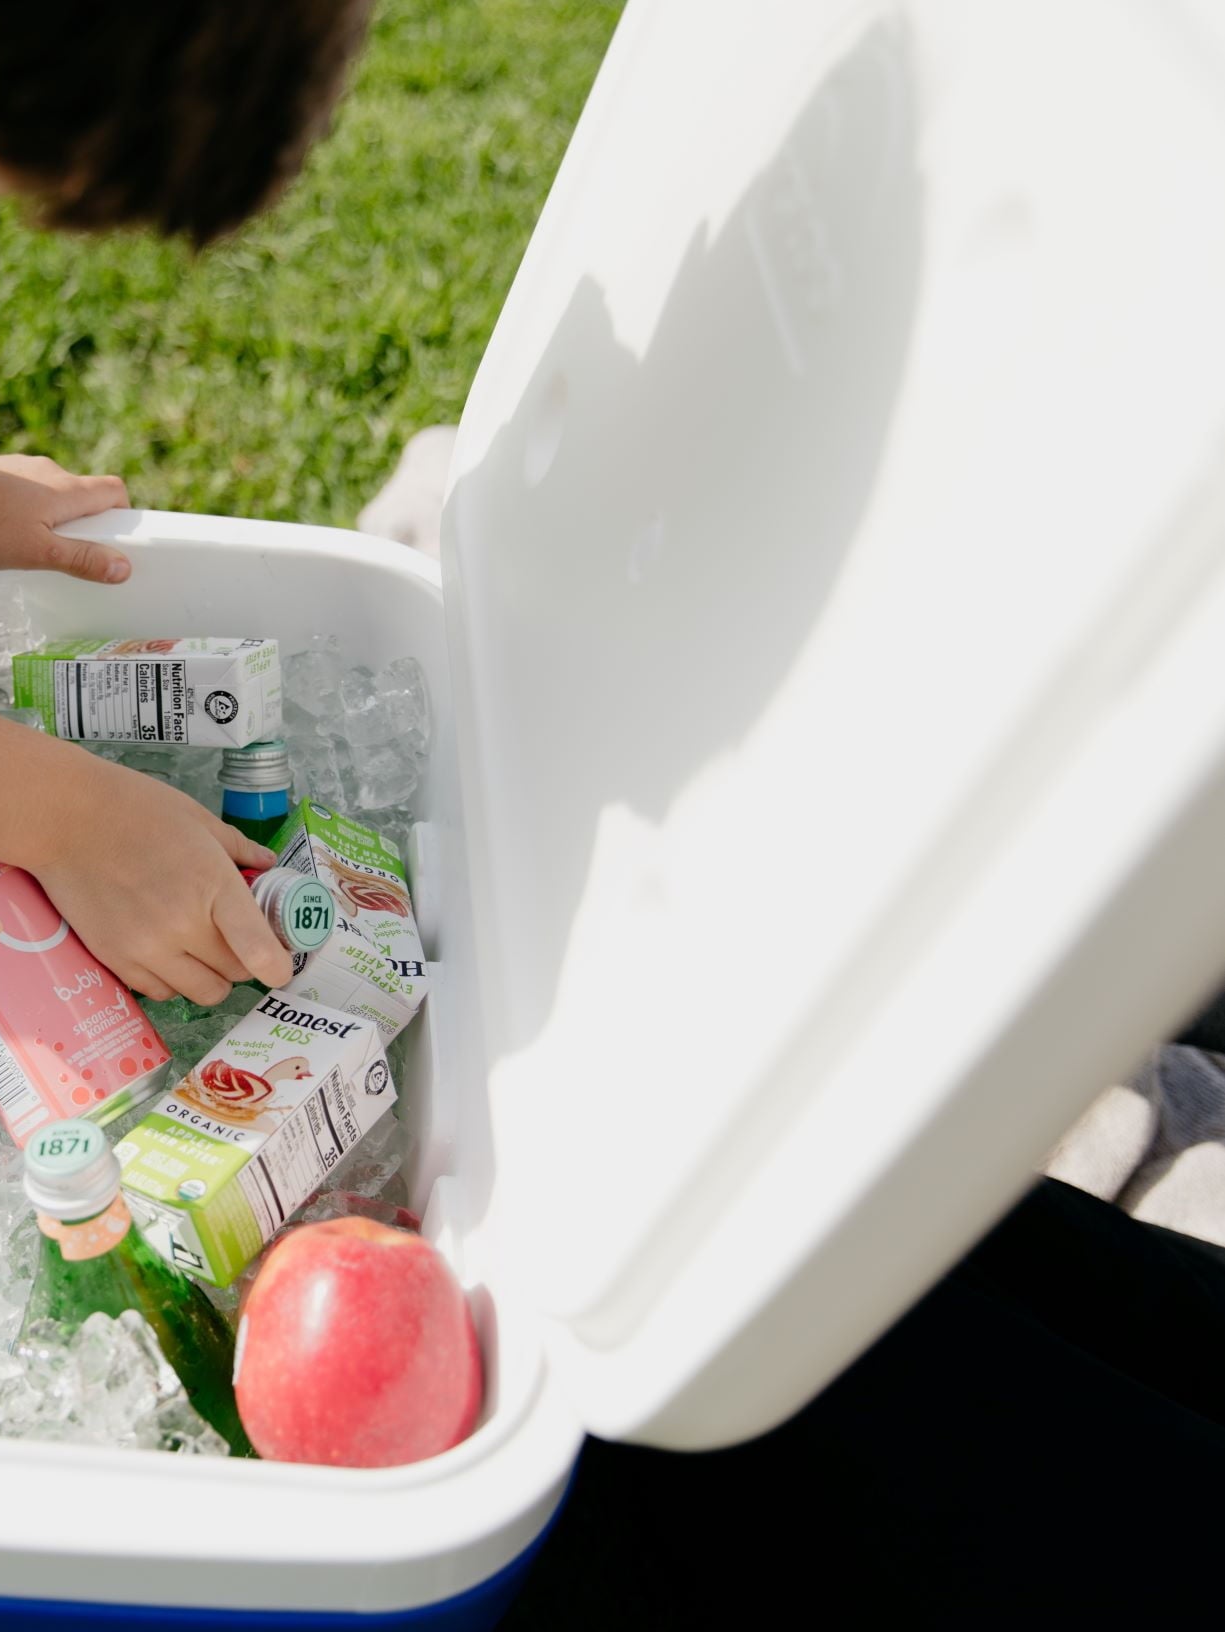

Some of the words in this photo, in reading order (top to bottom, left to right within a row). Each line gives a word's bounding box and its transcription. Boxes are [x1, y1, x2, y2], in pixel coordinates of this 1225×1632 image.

[139, 663, 150, 703] Calories
[171, 663, 184, 710] Nutrition
[187, 700, 195, 716] JUICE
[142, 725, 156, 741] 35
[173, 712, 185, 742] Facts
[324, 844, 400, 883] ORGANIC
[302, 895, 322, 904] SINCE
[294, 906, 329, 931] 1871
[375, 928, 403, 939] added
[53, 968, 103, 1002] bubly
[350, 965, 398, 994] APPLEY
[256, 996, 356, 1039] Honest
[226, 1039, 240, 1047] No
[243, 1040, 274, 1050] added
[329, 1070, 347, 1116] Nutrition
[341, 1113, 357, 1143] Facts
[144, 1127, 177, 1148] EVER
[165, 1104, 245, 1142] ORGANIC
[306, 1097, 322, 1136] Calories
[323, 1147, 339, 1168] 35
[38, 1137, 90, 1157] 1871
[165, 1125, 214, 1151] APPLEY
